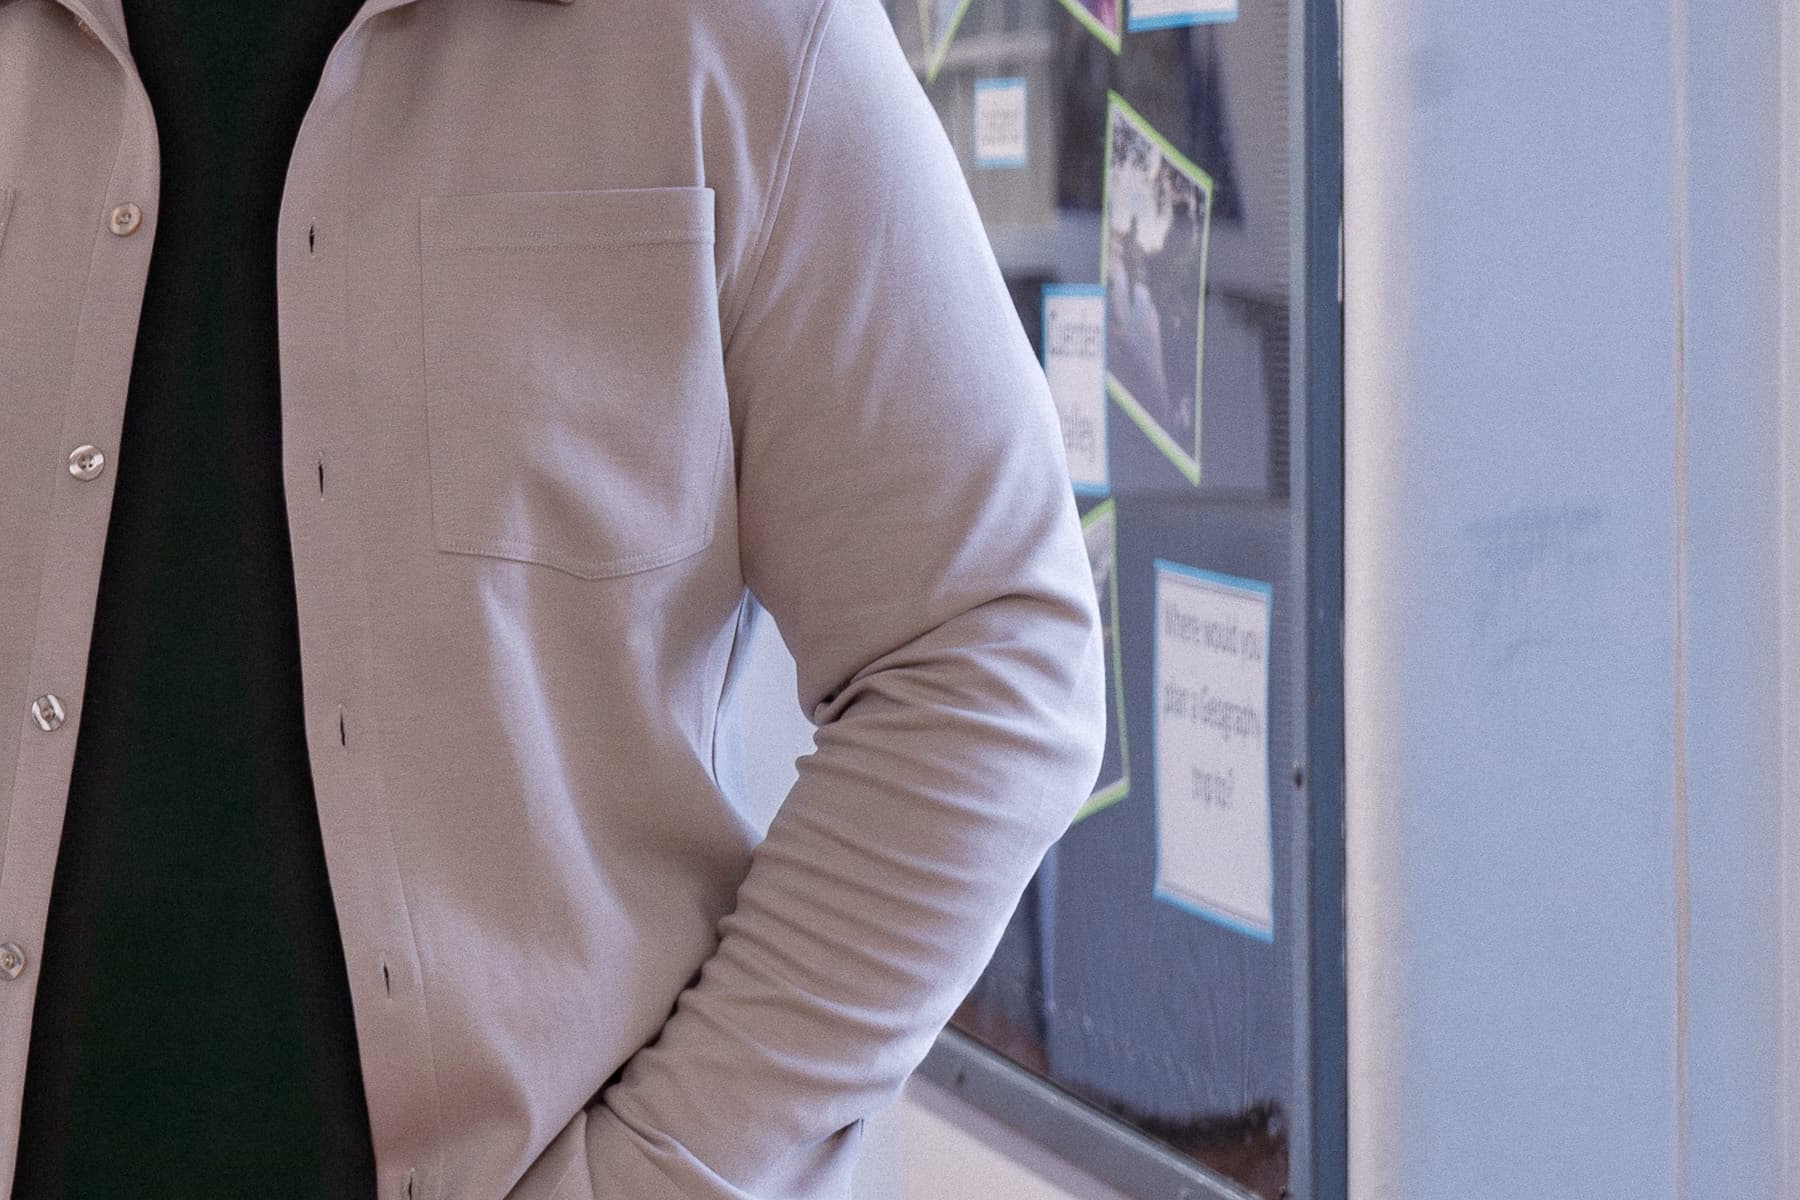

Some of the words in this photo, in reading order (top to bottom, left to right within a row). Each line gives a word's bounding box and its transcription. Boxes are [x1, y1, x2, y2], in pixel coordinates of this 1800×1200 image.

[1164, 601, 1200, 644] Where
[1204, 612, 1238, 654] would
[1241, 628, 1263, 669] you
[1200, 683, 1262, 752] Geography
[1192, 765, 1211, 810] trip
